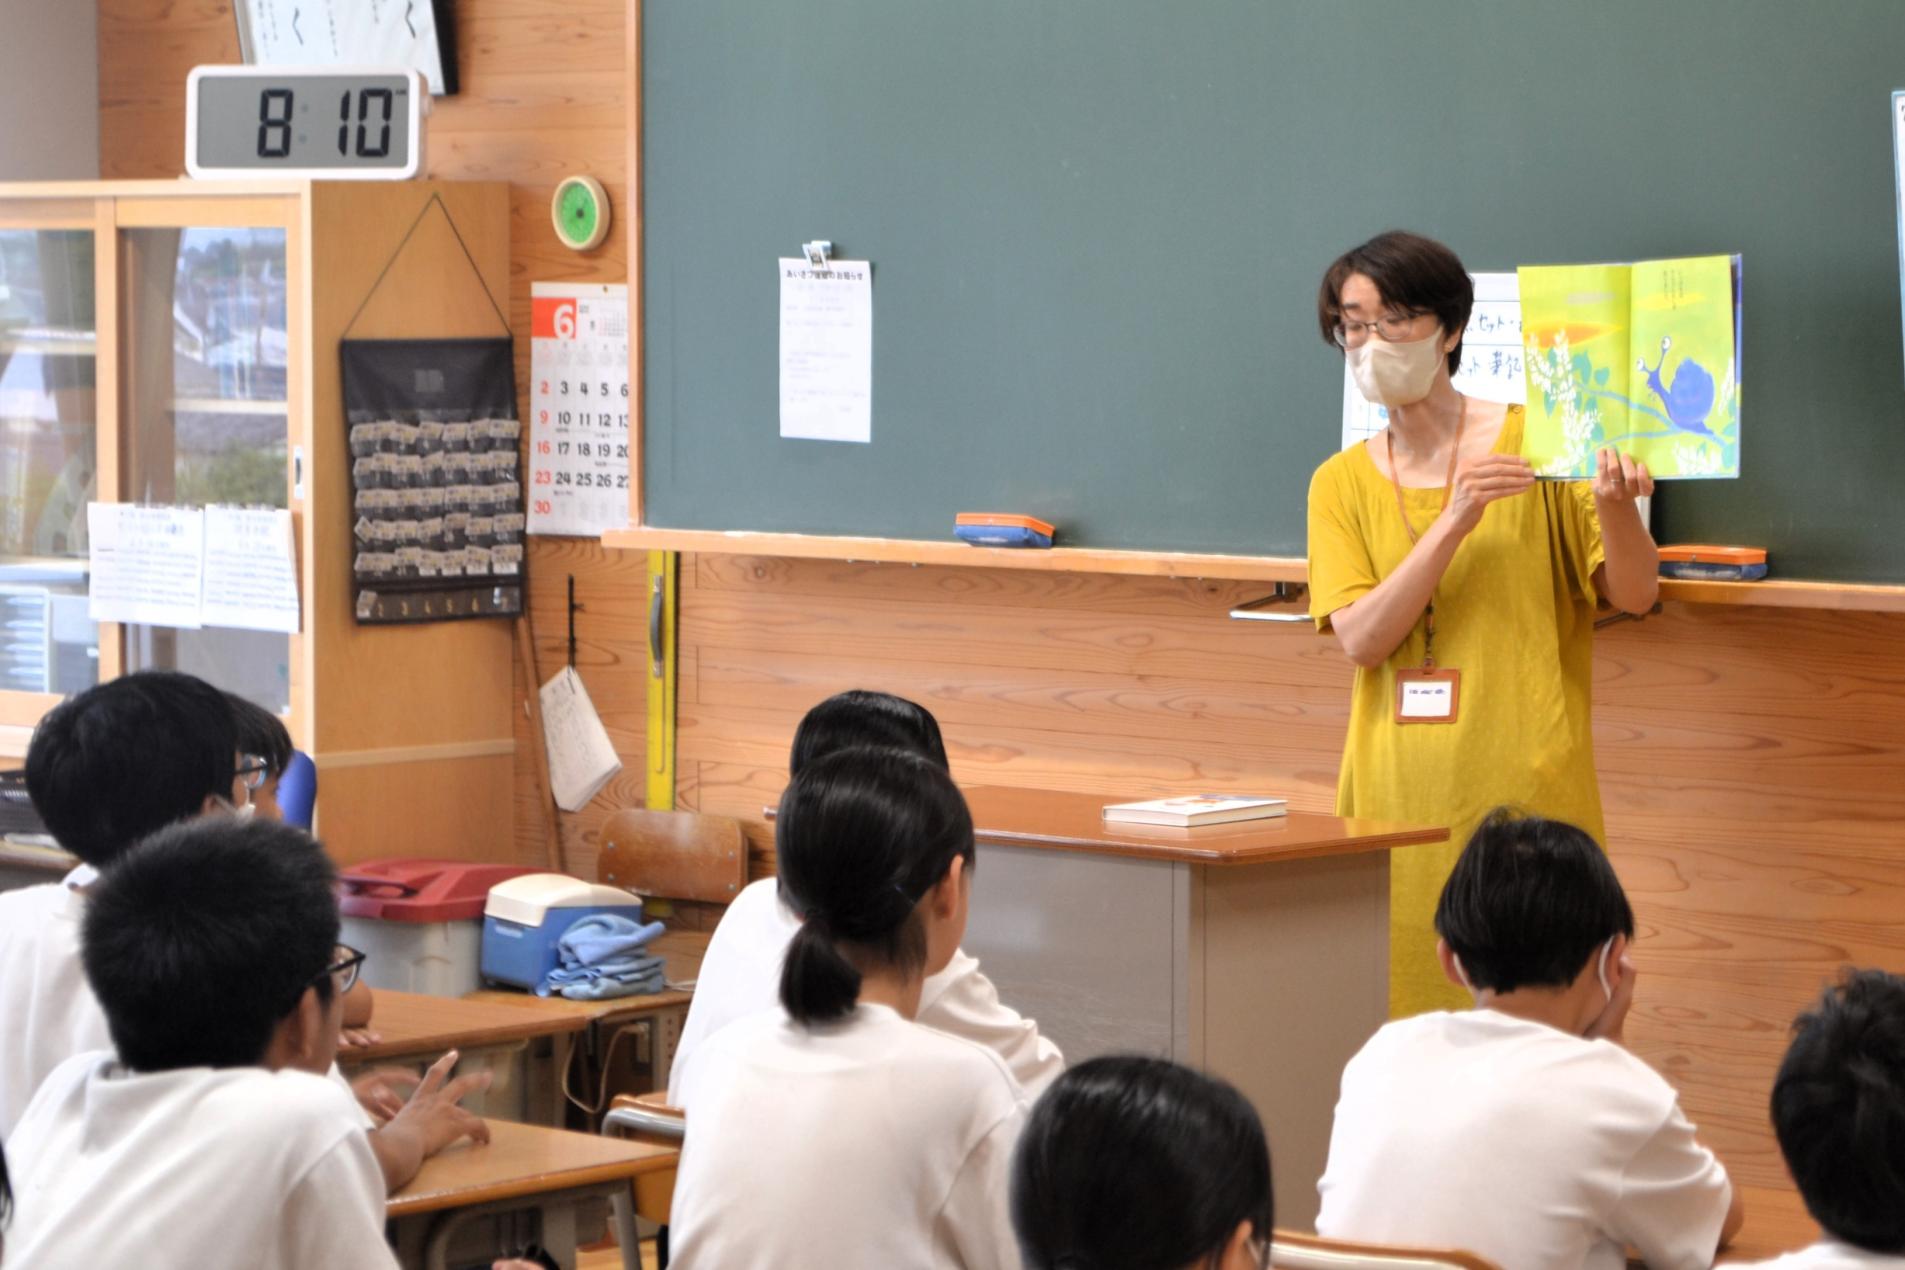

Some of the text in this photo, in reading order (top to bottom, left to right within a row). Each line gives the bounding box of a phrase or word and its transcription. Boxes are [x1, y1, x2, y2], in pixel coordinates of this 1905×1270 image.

[553, 303, 575, 340] 6
[540, 380, 628, 397] 2 3 4 5 6
[540, 410, 549, 425] 9
[558, 411, 572, 425] 10
[579, 412, 591, 427] 11
[598, 413, 612, 428] 12
[537, 440, 551, 455] 16
[558, 441, 570, 455] 17
[578, 442, 591, 457] 18
[598, 443, 611, 457] 19
[536, 469, 551, 484] 23
[555, 471, 571, 485] 24
[576, 472, 592, 487] 25
[596, 473, 612, 488] 26
[535, 500, 551, 514] 30
